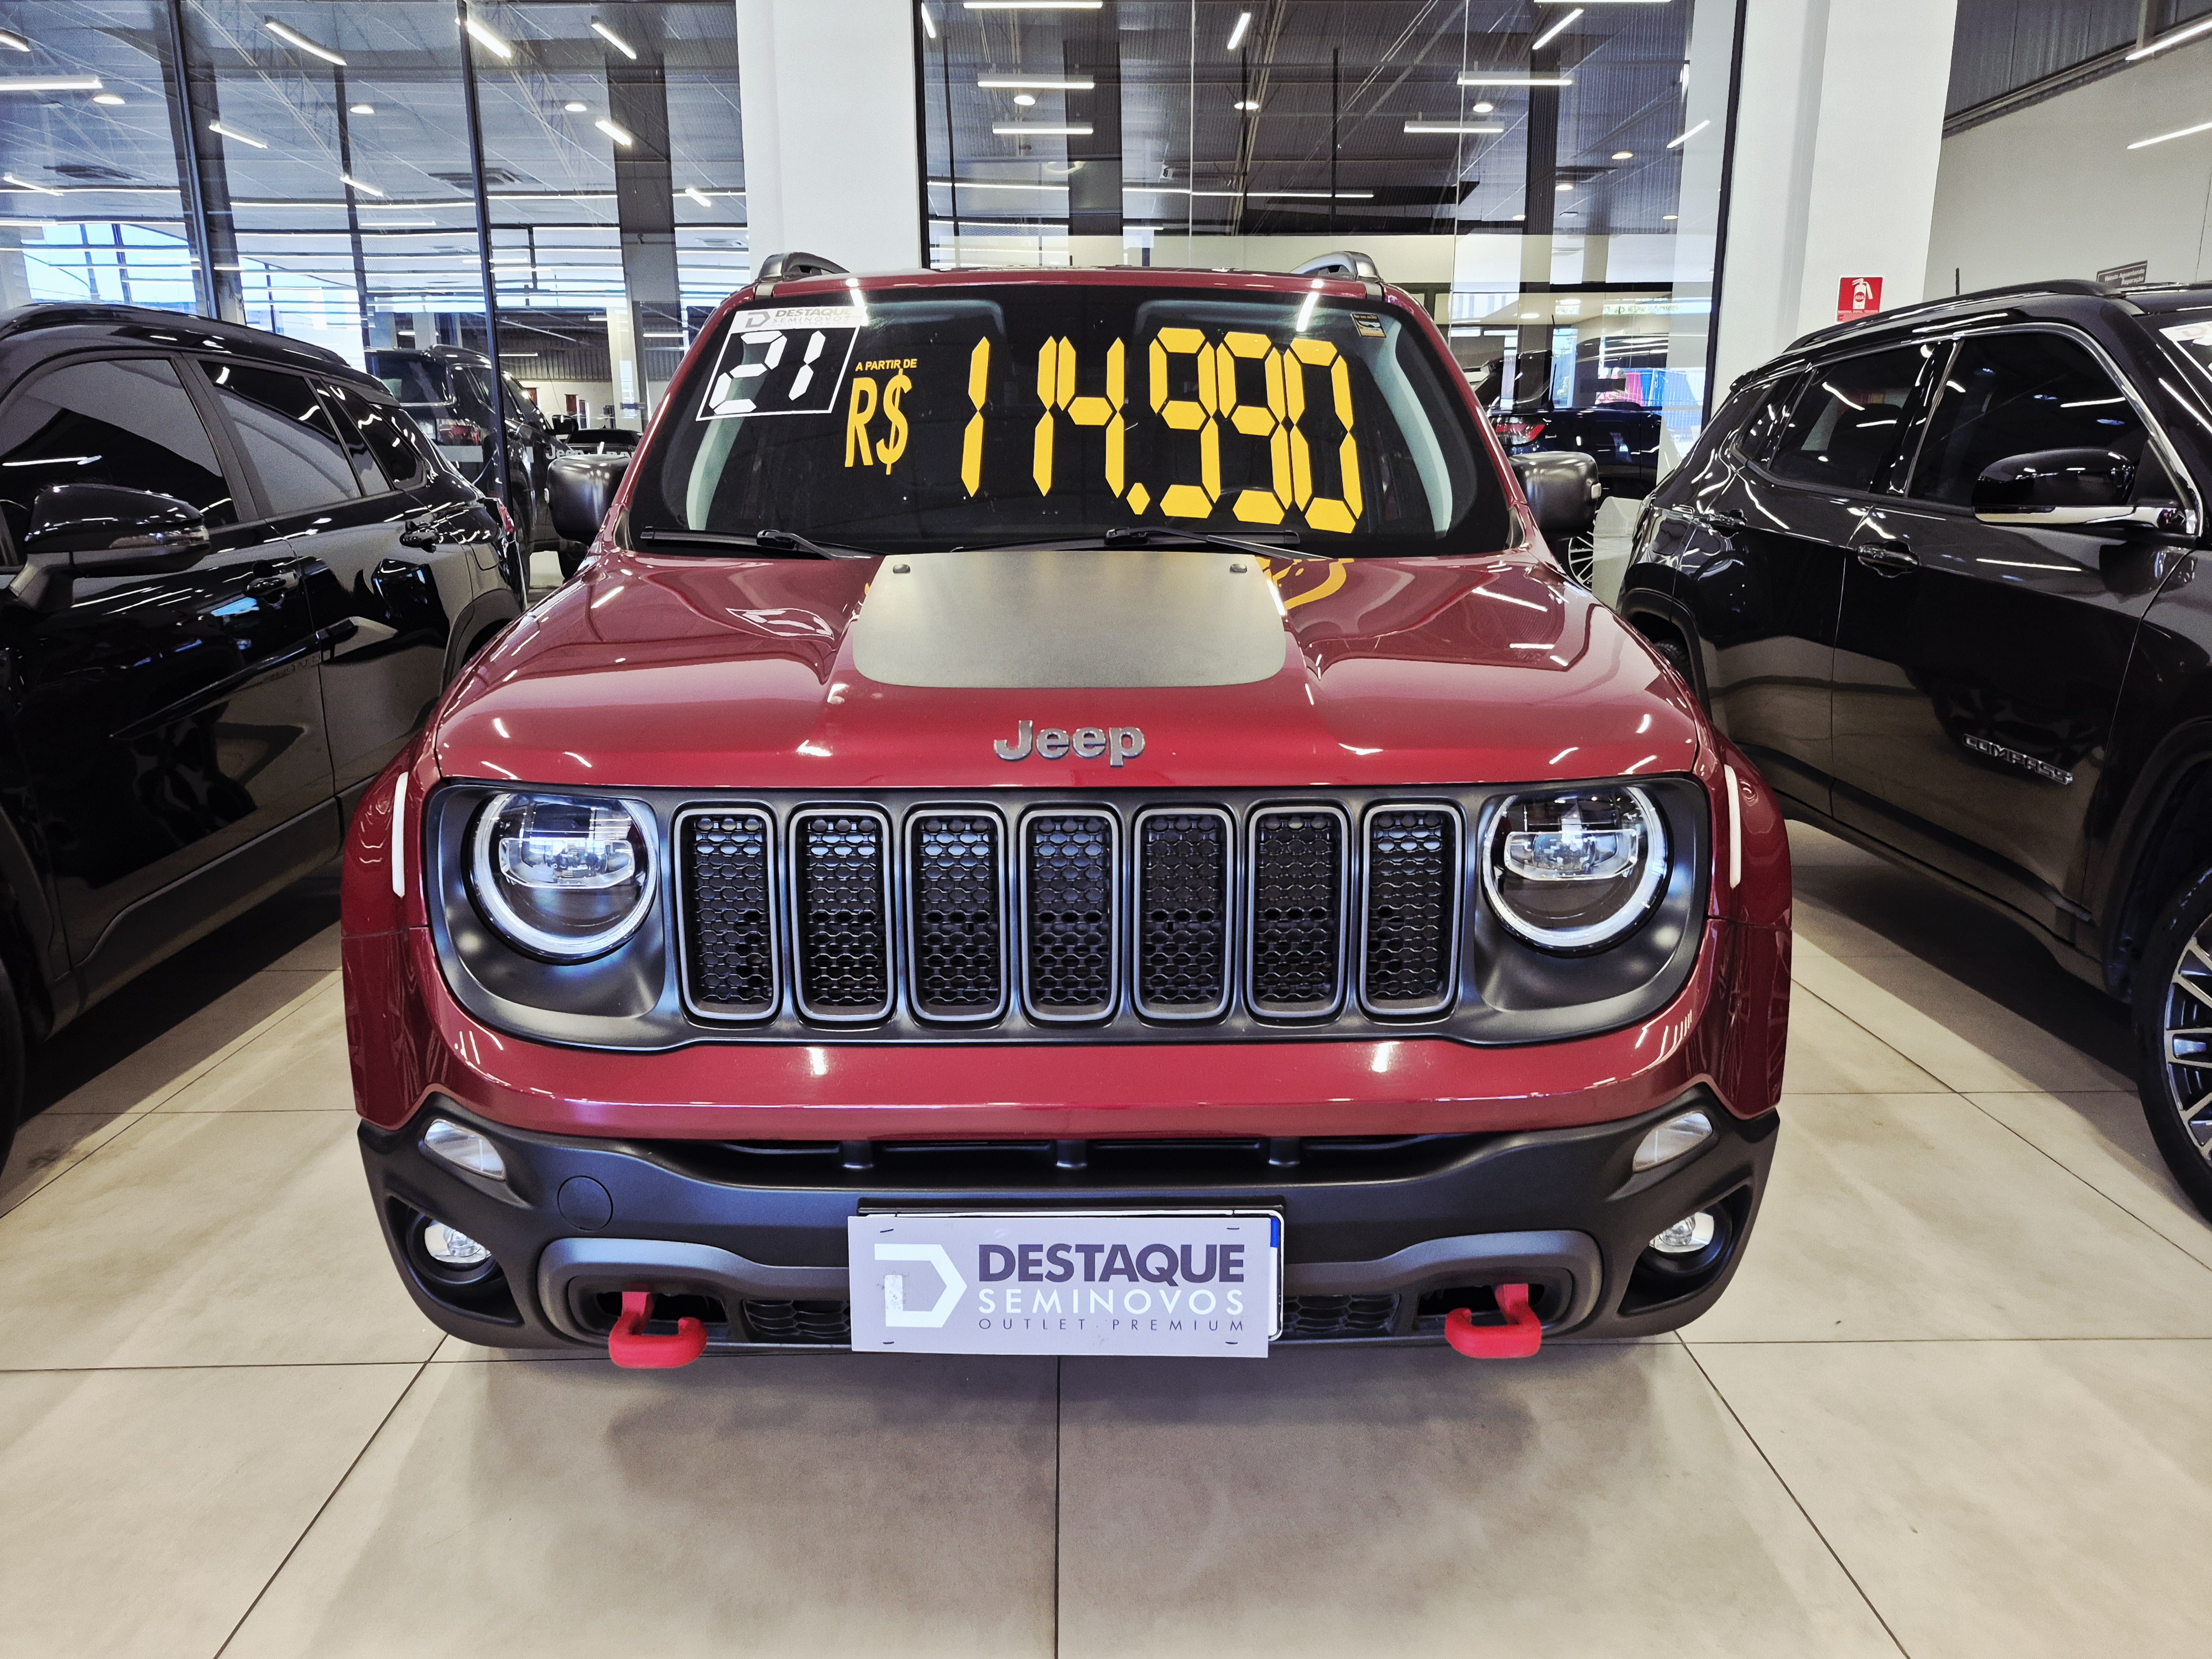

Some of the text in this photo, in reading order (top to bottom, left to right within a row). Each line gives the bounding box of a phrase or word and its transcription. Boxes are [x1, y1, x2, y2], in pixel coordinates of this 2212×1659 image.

[775, 308, 852, 317] DESTAQUE
[708, 330, 826, 415] 21
[855, 358, 917, 372] A PARTIR DE
[844, 327, 1363, 534] R$ 114.990
[994, 719, 1145, 768] Jeep
[1963, 733, 2073, 785] COMPASS
[979, 1243, 1244, 1286] DESTAQUE
[979, 1288, 1243, 1315] SEMINOVOS
[979, 1318, 1244, 1332] OUTLET PREMIUM
